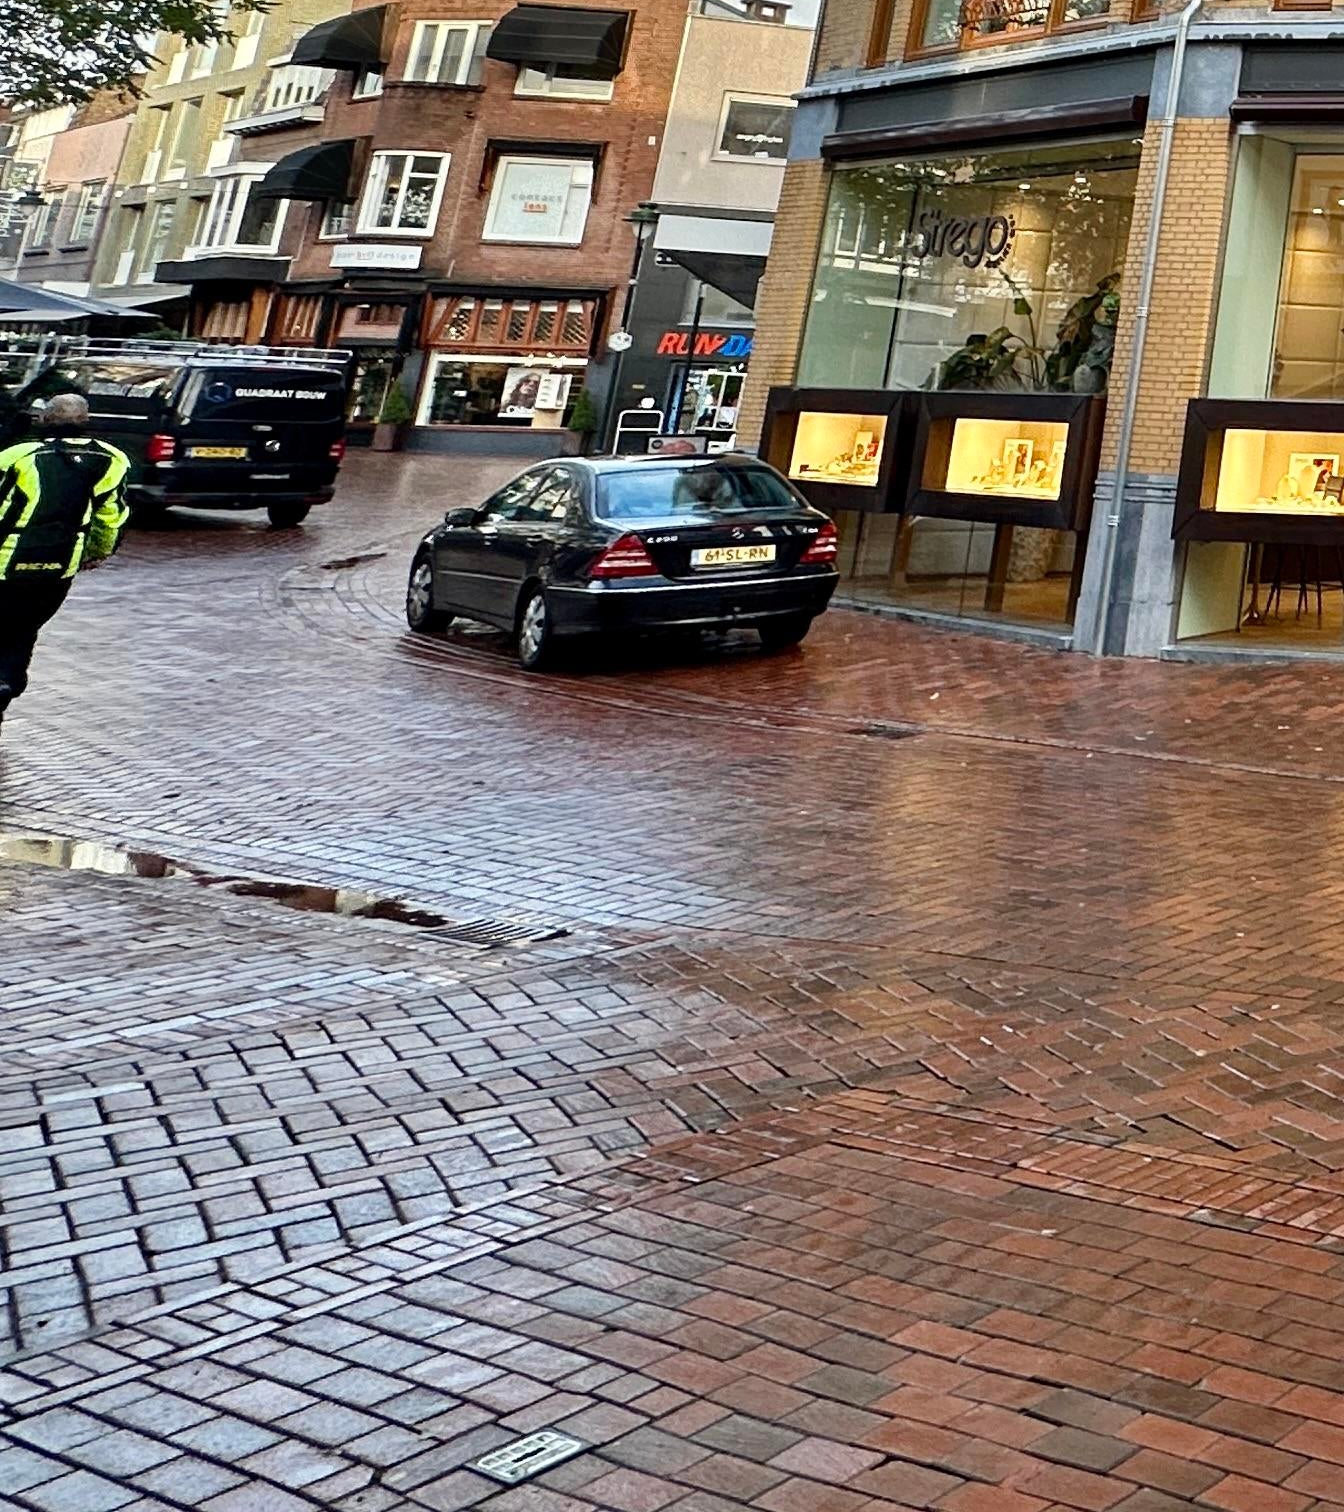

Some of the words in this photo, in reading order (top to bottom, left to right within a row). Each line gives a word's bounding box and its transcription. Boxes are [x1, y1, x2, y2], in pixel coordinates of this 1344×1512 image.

[910, 209, 1008, 268] Strego
[235, 389, 293, 399] QUADRAAT
[295, 390, 327, 400] BOUW
